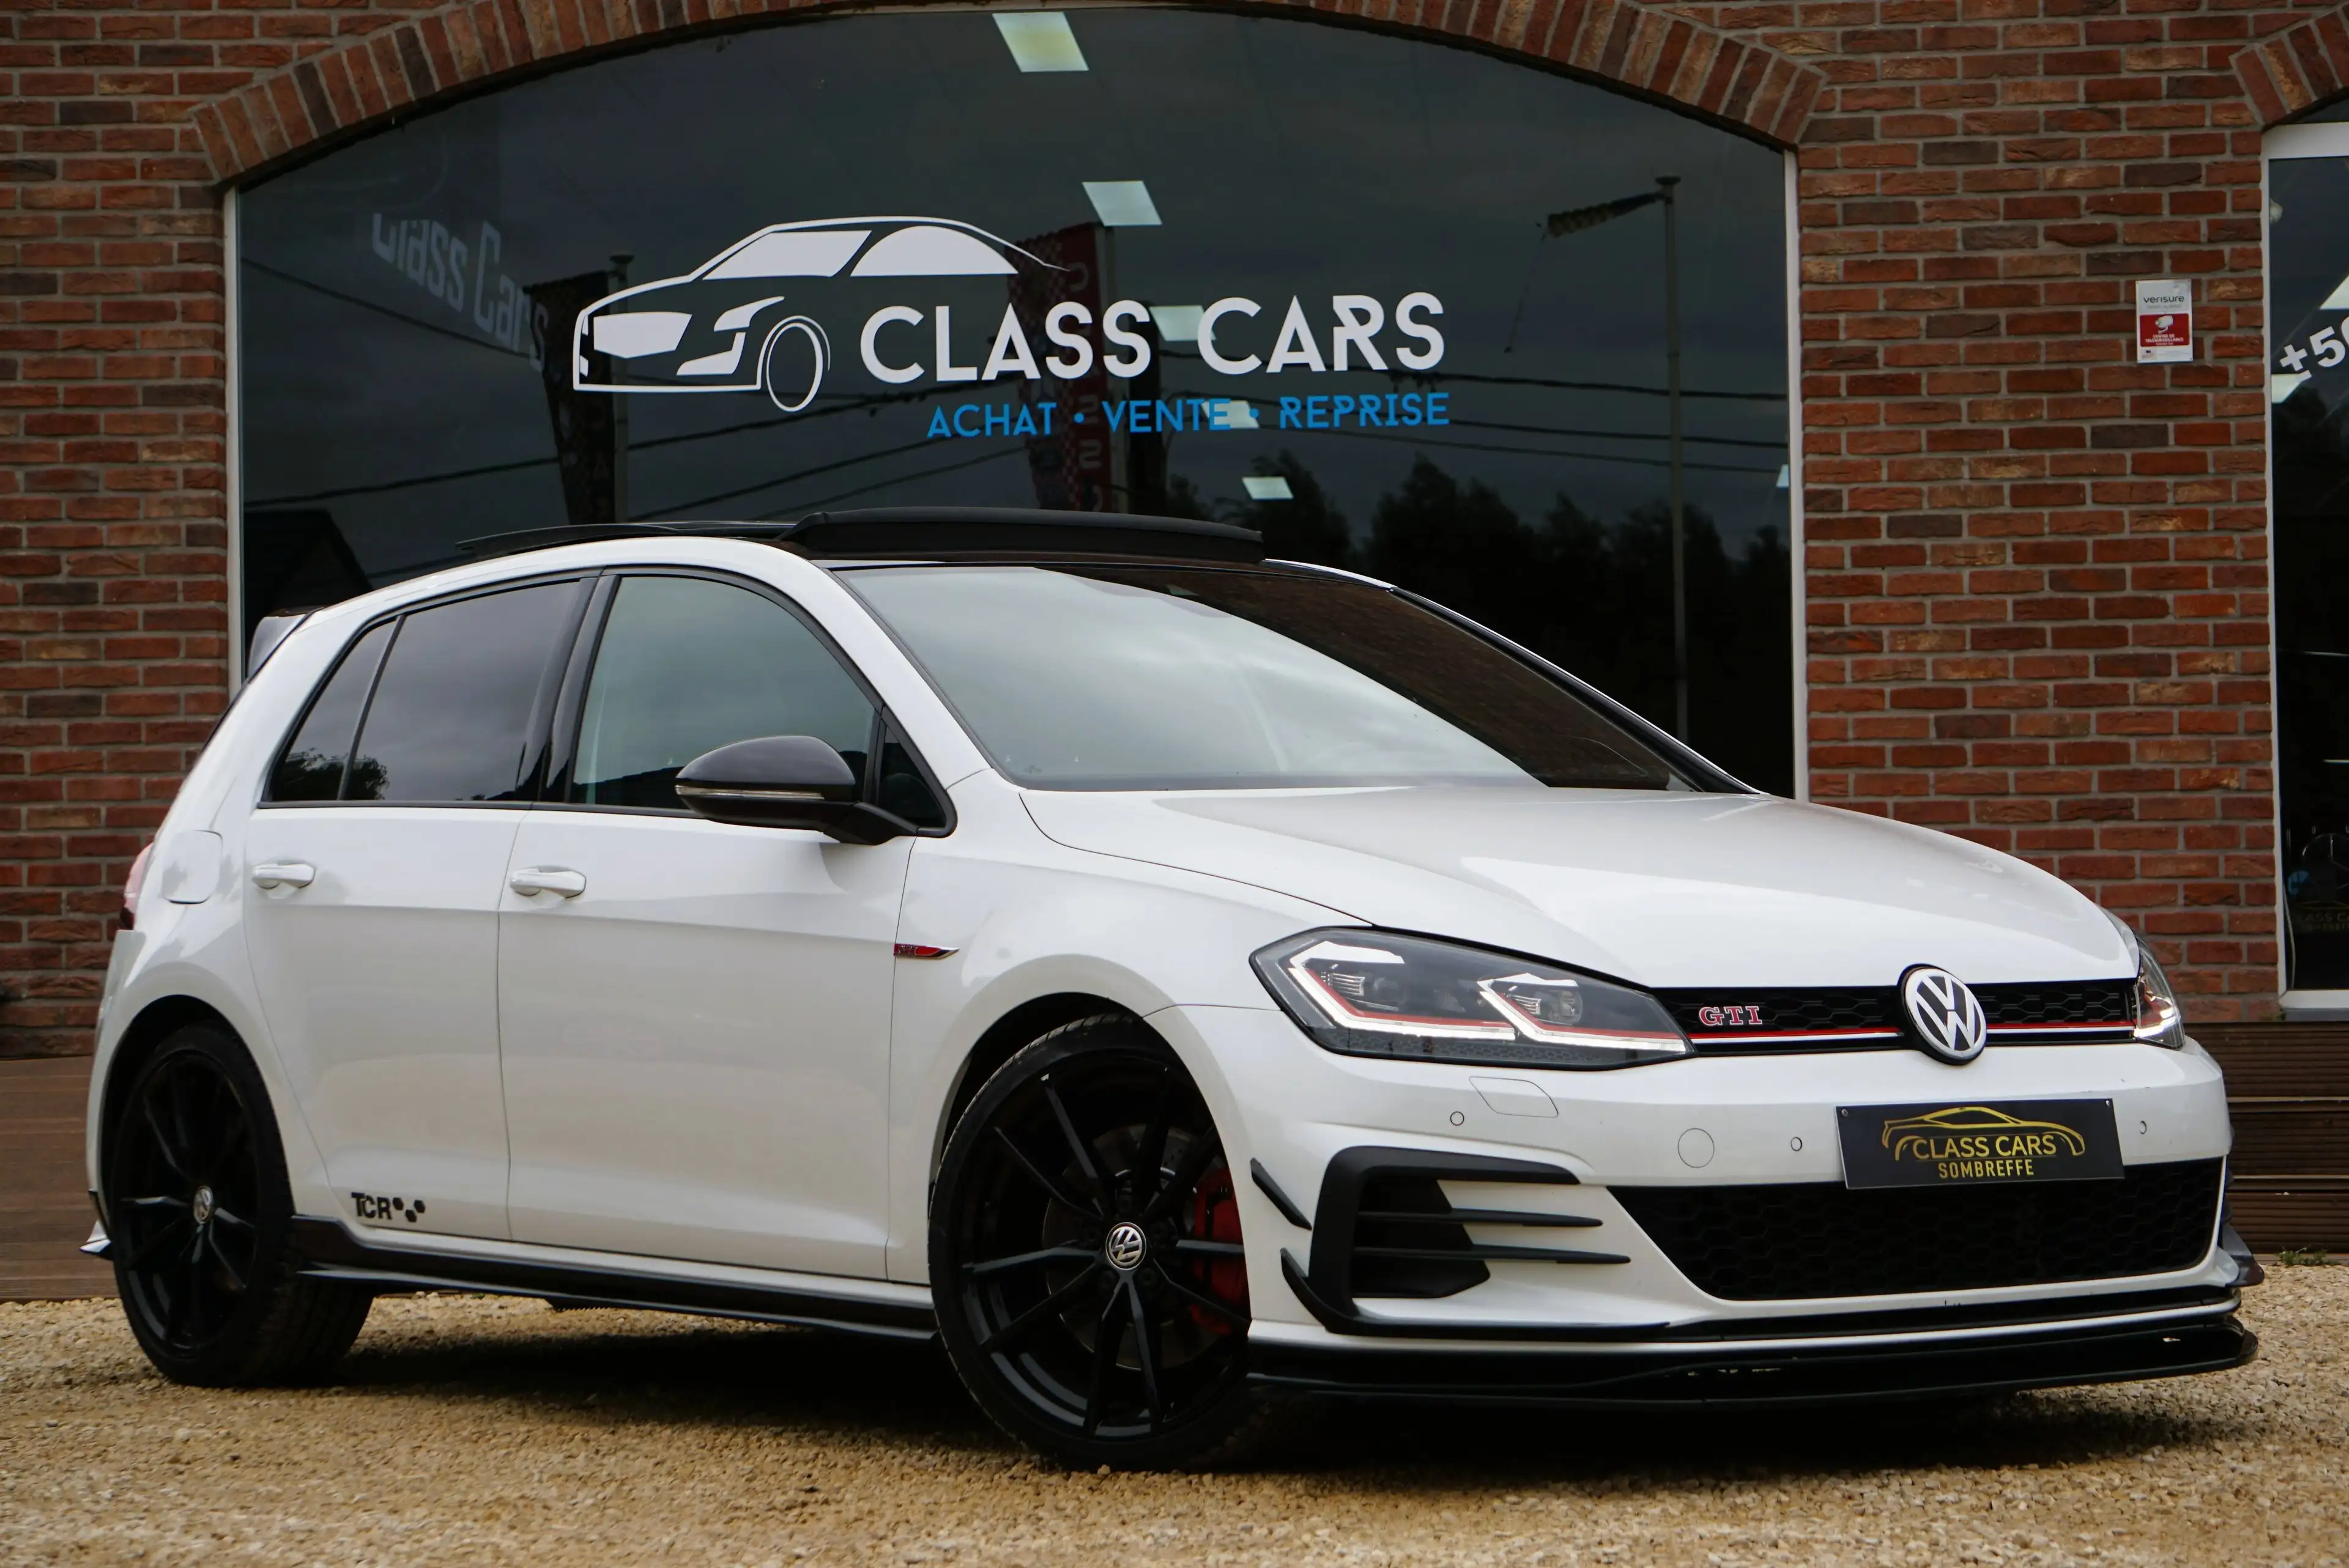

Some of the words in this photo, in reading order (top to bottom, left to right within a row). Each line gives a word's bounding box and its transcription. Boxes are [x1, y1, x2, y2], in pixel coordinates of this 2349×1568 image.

[473, 220, 549, 372] Cars
[859, 301, 1151, 383] CLASS
[1197, 294, 1444, 375] CARS
[927, 402, 1057, 438] ACHAT
[1102, 398, 1233, 433] VENTE
[1279, 393, 1450, 429] REPRISE
[1699, 1005, 1763, 1026] GTI
[1912, 1136, 1991, 1159] CLASS
[1995, 1134, 2057, 1157] CARS
[1938, 1159, 2035, 1179] SOMBREFFE
[351, 1191, 392, 1220] TCR
